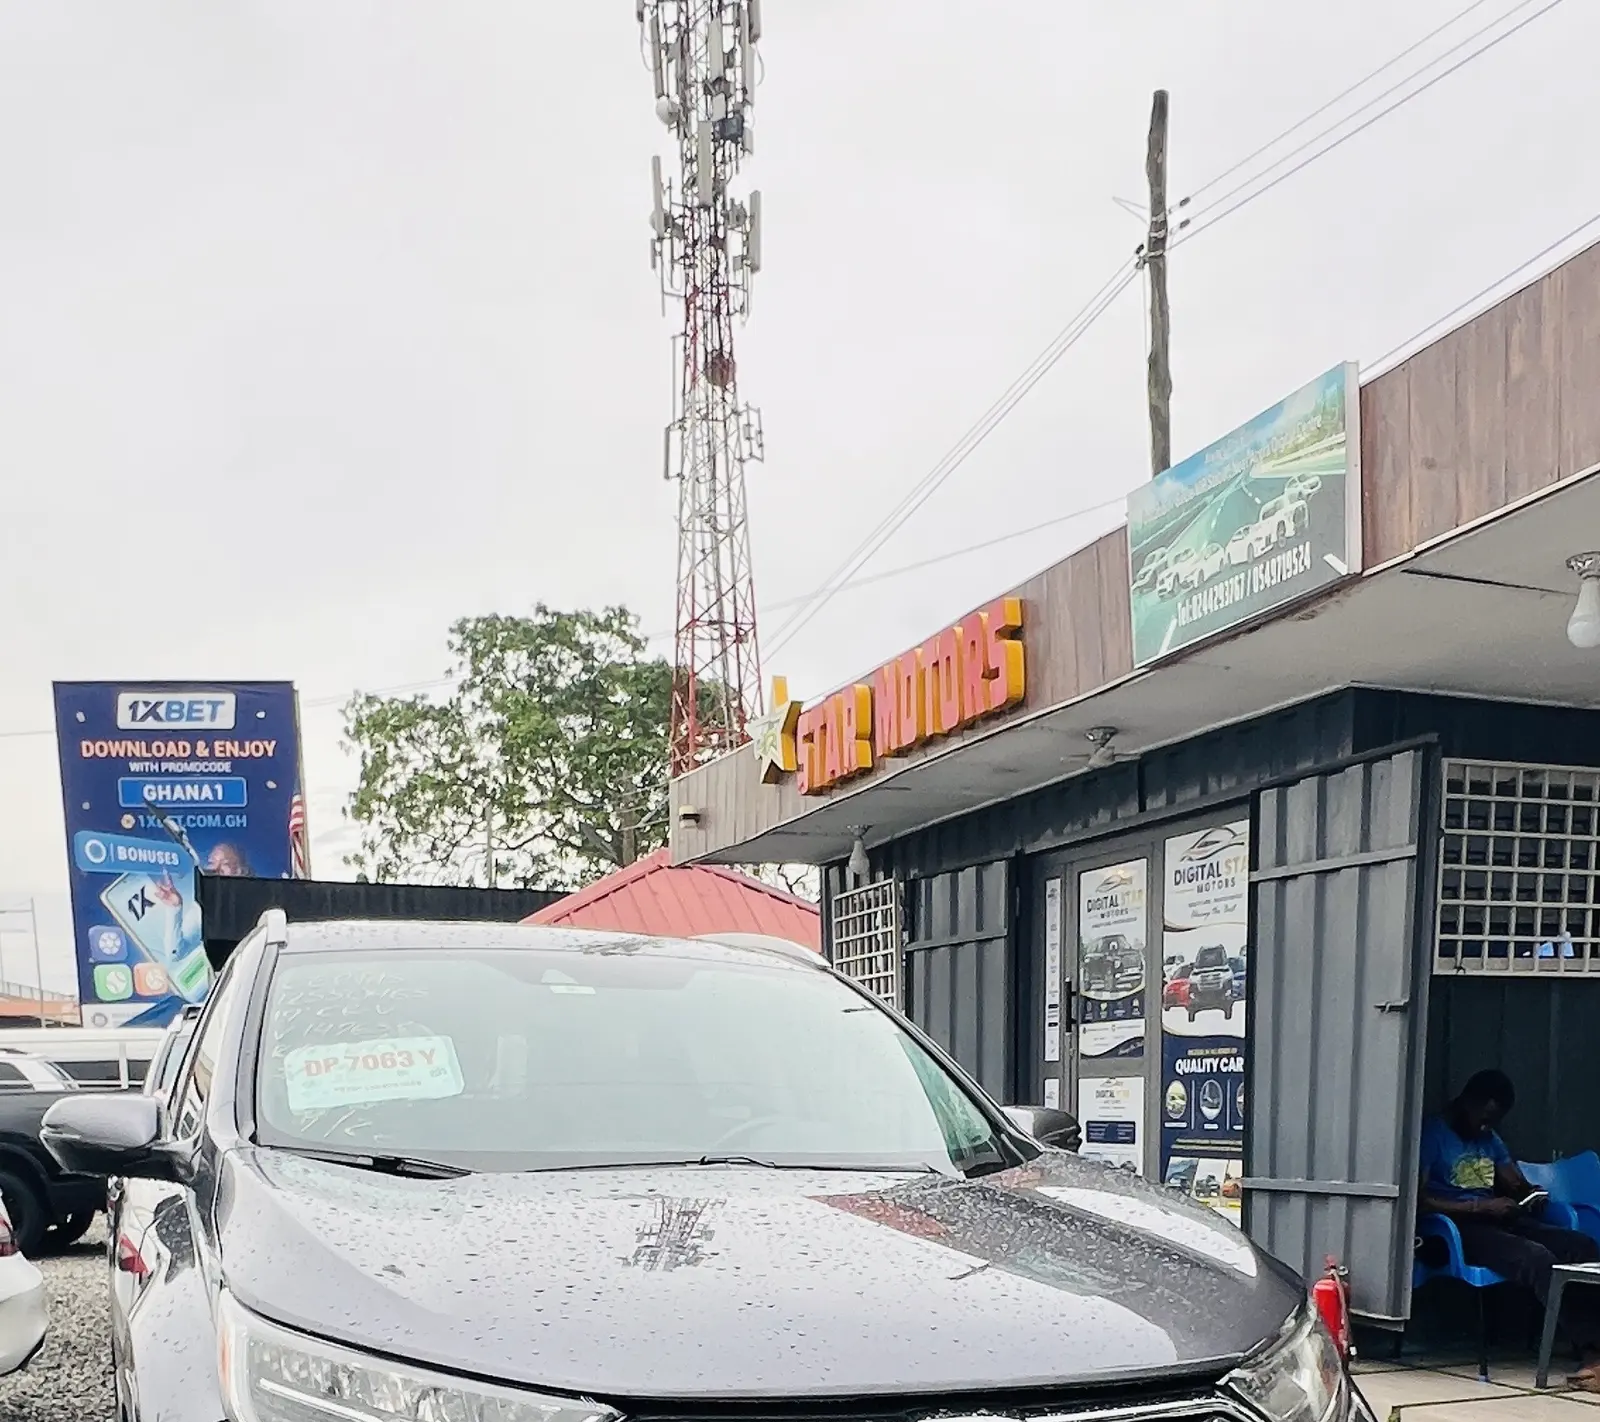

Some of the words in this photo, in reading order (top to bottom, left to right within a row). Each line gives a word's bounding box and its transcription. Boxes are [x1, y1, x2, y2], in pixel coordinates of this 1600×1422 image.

[796, 684, 873, 796] STAR
[873, 597, 1025, 759] MOTORS
[128, 700, 226, 723] 1XBET
[81, 740, 191, 758] DOWNLOAD
[195, 740, 210, 758] &
[214, 740, 277, 758] ENJOY
[129, 762, 159, 773] WITH
[161, 762, 232, 774] PROMOCODE
[143, 784, 224, 801] GHANA1
[117, 846, 180, 866] BONUSES
[1174, 861, 1222, 886] DIGITAL
[1196, 877, 1236, 894] MOTORS
[304, 1057, 339, 1077] DP
[344, 1050, 415, 1072] 7063
[418, 1049, 436, 1066] Y
[1175, 1057, 1219, 1075] QUALITY
